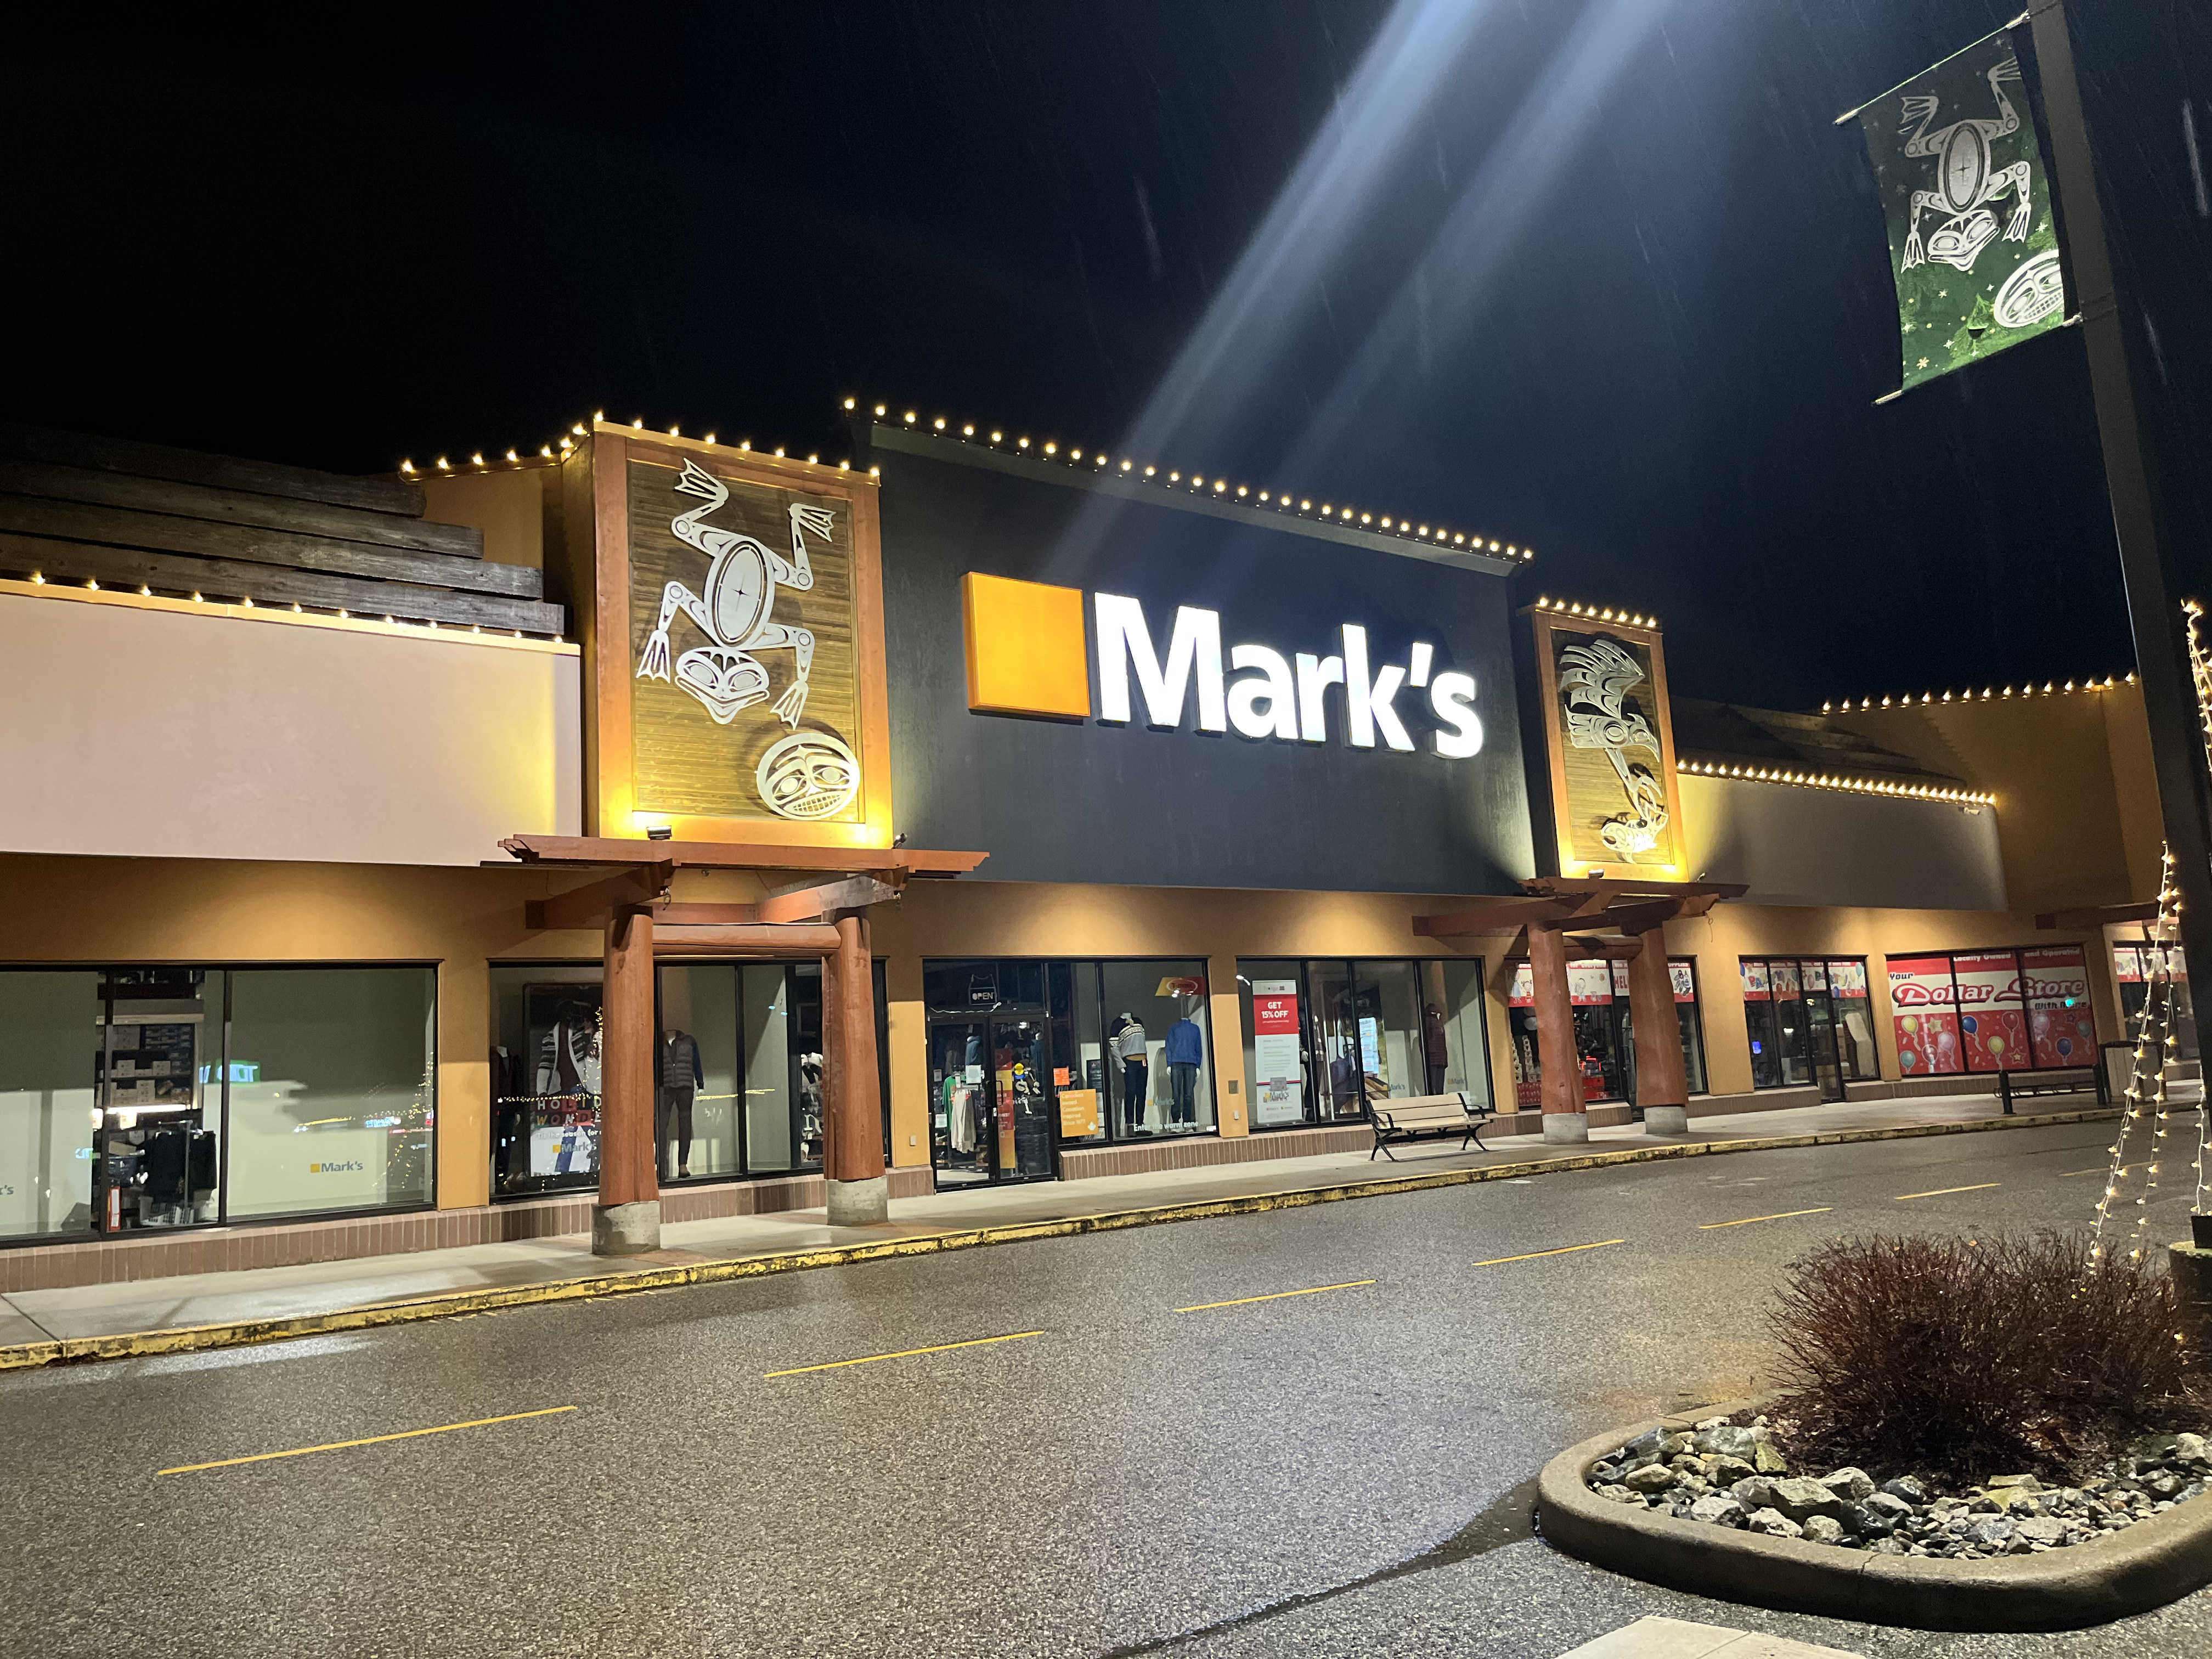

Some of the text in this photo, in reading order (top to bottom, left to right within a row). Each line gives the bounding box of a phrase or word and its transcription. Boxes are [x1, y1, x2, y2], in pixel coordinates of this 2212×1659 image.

[1094, 592, 1483, 759] Mark's
[1892, 977, 2084, 1007] Dollar Store
[537, 1097, 602, 1110] HOLID
[537, 1112, 602, 1126] WONDE
[561, 1142, 596, 1153] Mark's
[321, 1161, 363, 1172] Mark's
